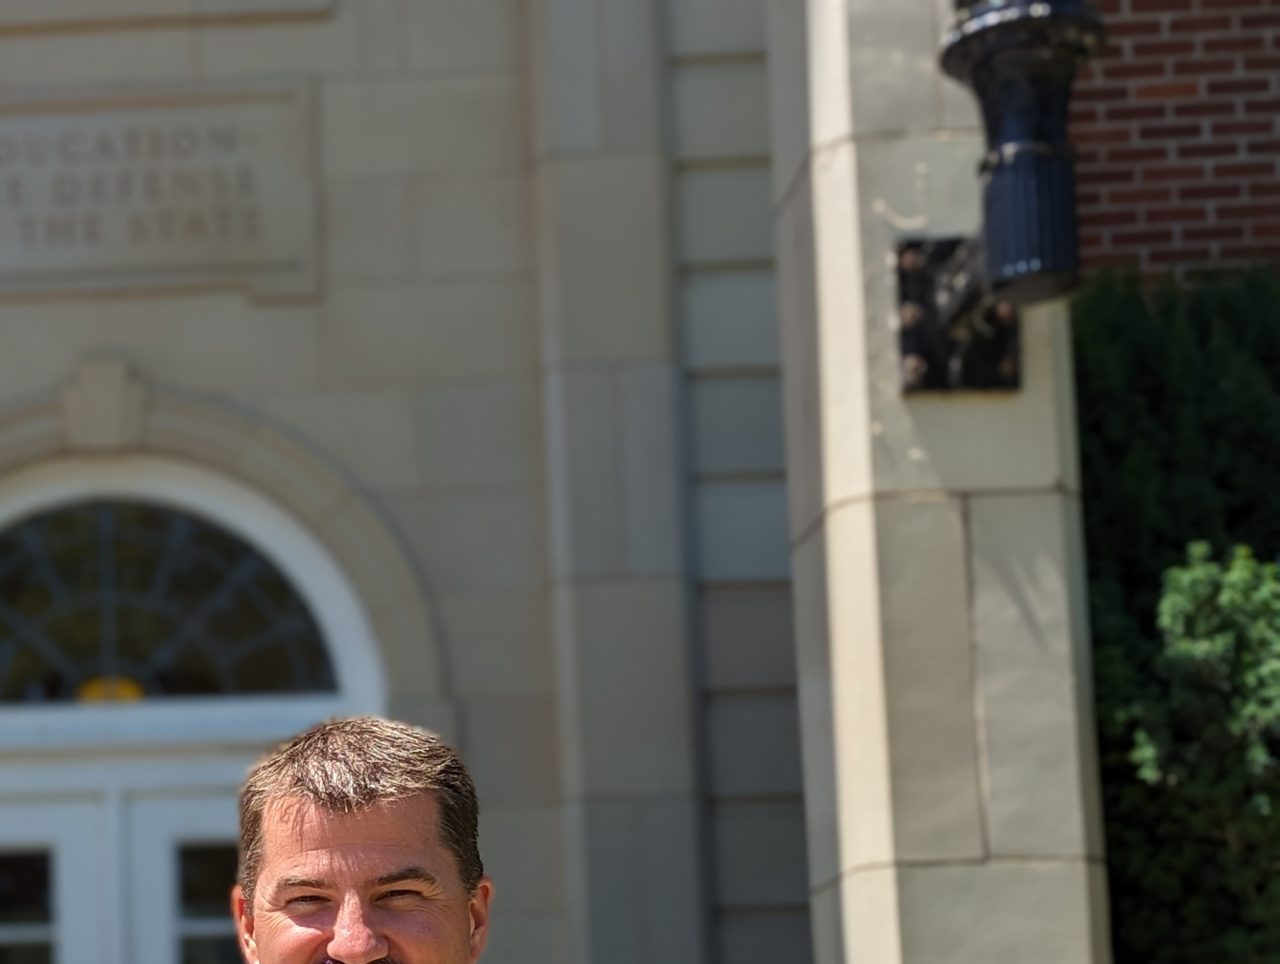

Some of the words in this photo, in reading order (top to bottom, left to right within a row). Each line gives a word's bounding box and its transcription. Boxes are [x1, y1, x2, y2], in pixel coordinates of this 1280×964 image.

[51, 164, 254, 206] DEFENSE
[20, 212, 102, 249] THE
[128, 205, 262, 245] STATE
